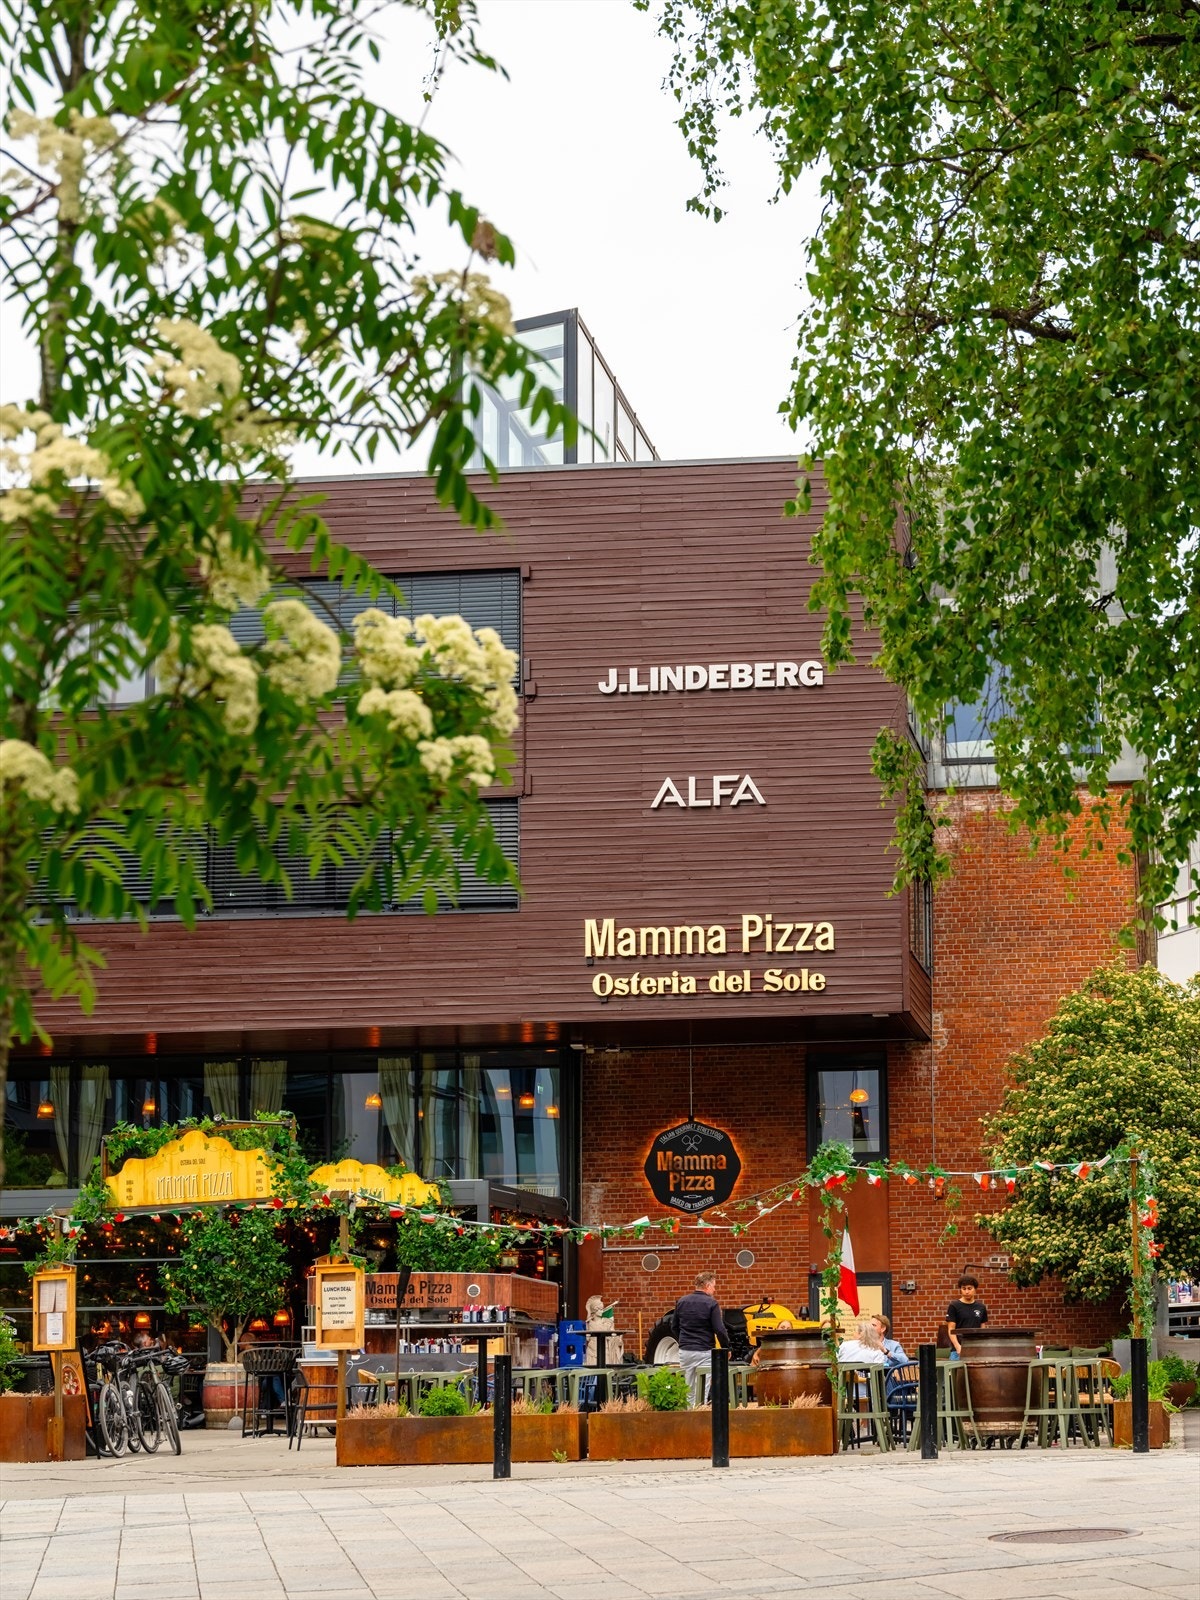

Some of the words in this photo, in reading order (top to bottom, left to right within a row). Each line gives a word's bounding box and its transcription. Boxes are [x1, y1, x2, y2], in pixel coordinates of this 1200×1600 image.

[599, 660, 824, 694] J.LINDEBERG
[650, 774, 767, 809] ALFA
[584, 918, 727, 958] Mamma
[742, 914, 836, 954] Pizza
[592, 971, 698, 997] Osteria
[709, 970, 752, 993] del
[764, 968, 827, 992] Sole
[657, 1151, 727, 1171] Mamma
[156, 1173, 199, 1200] MAMMA
[202, 1171, 234, 1197] PIZZA
[669, 1172, 715, 1192] Pizza
[365, 1281, 415, 1295] Mama
[420, 1280, 453, 1295] Pizza
[370, 1296, 406, 1304] Ostera
[411, 1295, 424, 1304] del
[427, 1295, 449, 1304] Sole
